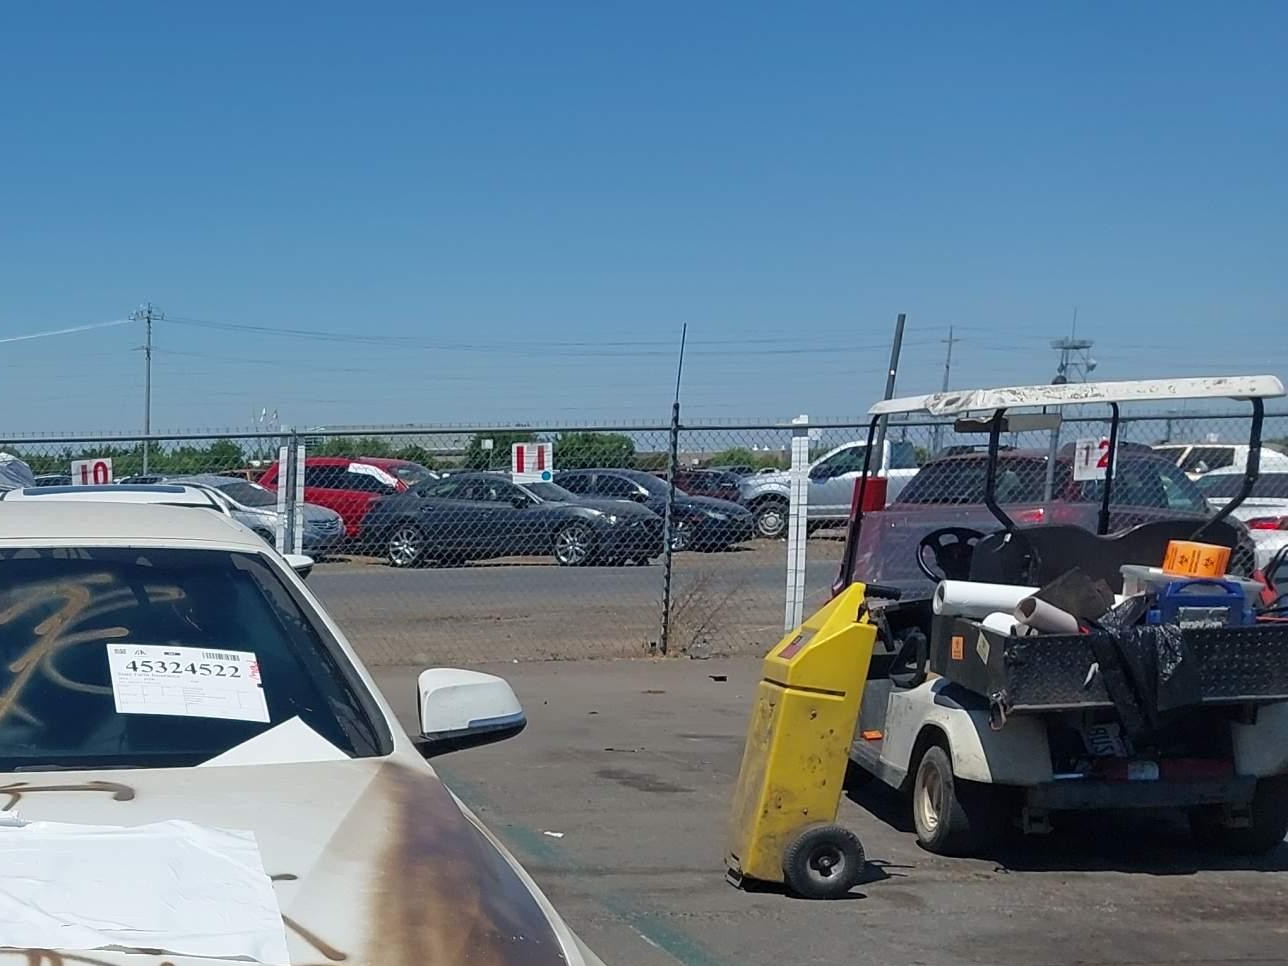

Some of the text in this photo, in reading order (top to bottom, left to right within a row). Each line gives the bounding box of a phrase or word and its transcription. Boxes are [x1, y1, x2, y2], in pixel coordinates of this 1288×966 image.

[1083, 440, 1111, 469] 12
[81, 461, 109, 485] 10
[125, 660, 242, 679] 45324522
